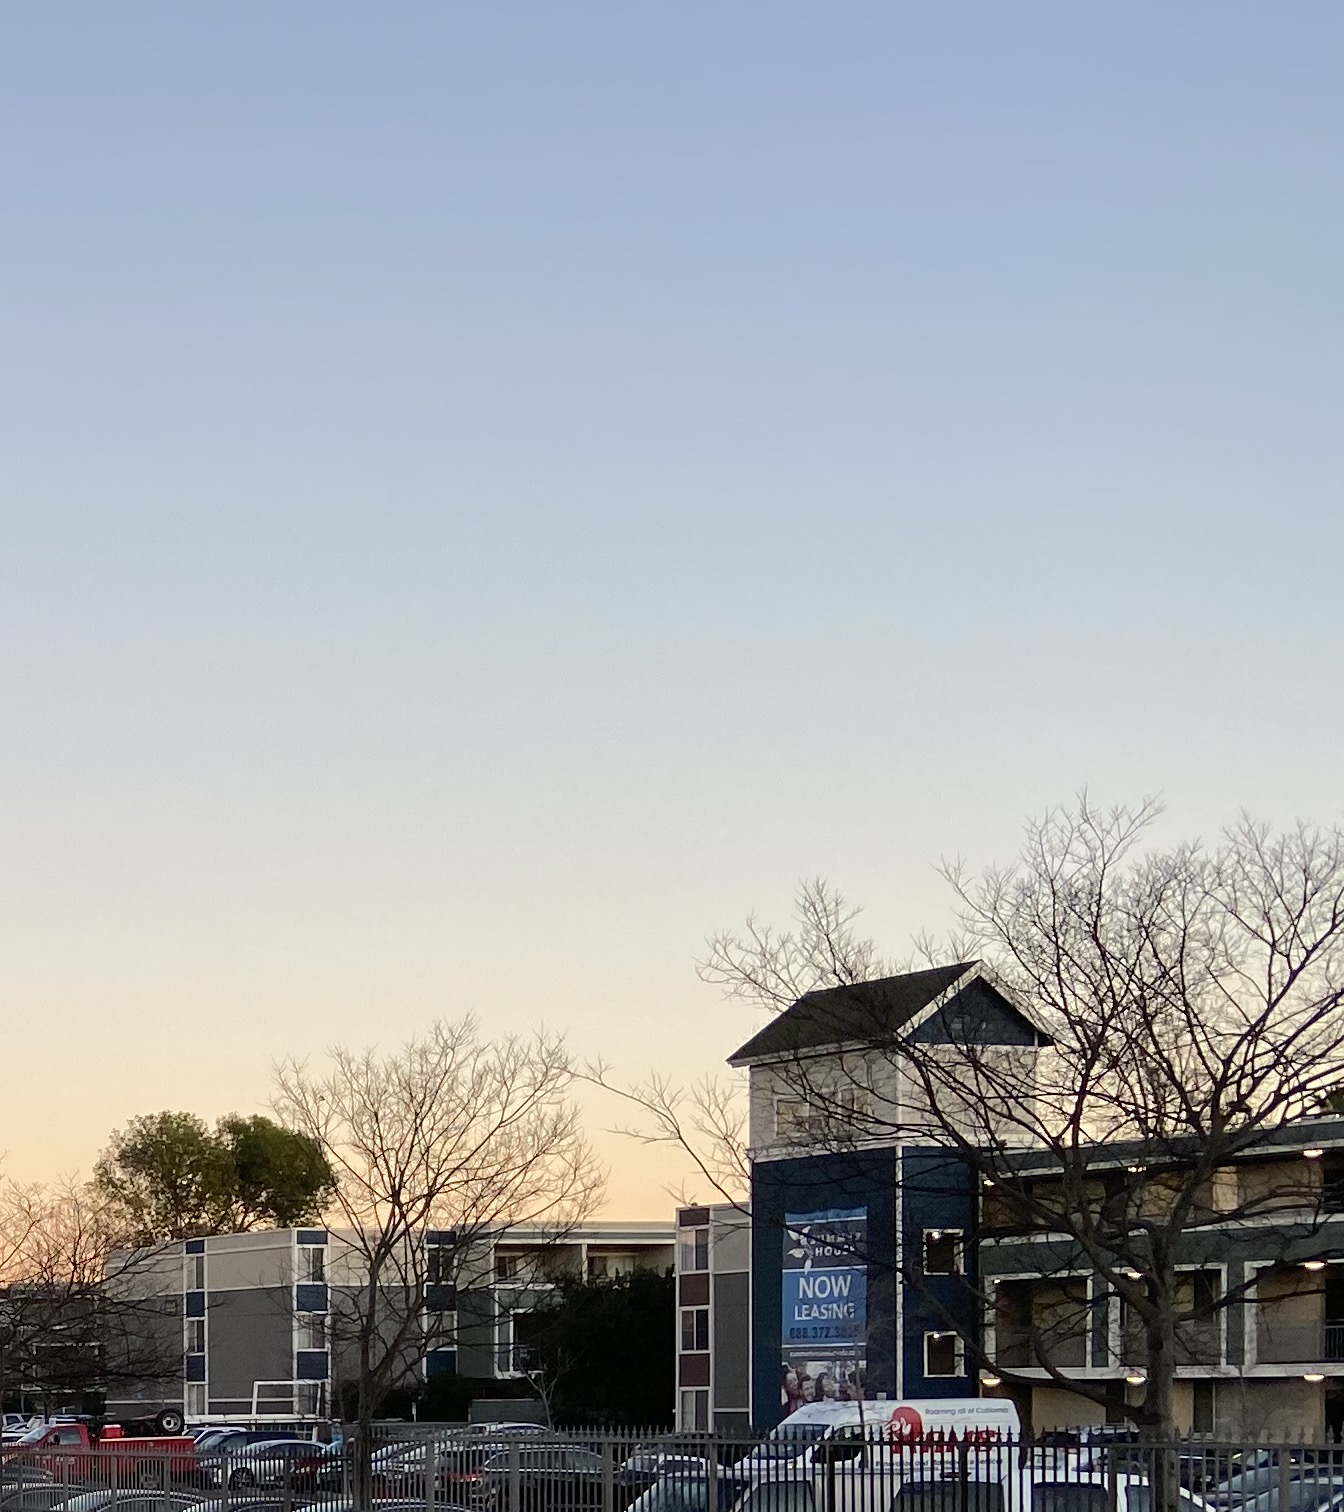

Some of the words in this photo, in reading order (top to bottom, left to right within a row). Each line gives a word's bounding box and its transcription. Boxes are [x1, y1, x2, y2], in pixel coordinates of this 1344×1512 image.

[798, 1274, 852, 1299] NOW
[794, 1302, 855, 1321] LEASING
[925, 1408, 956, 1416] Roaming
